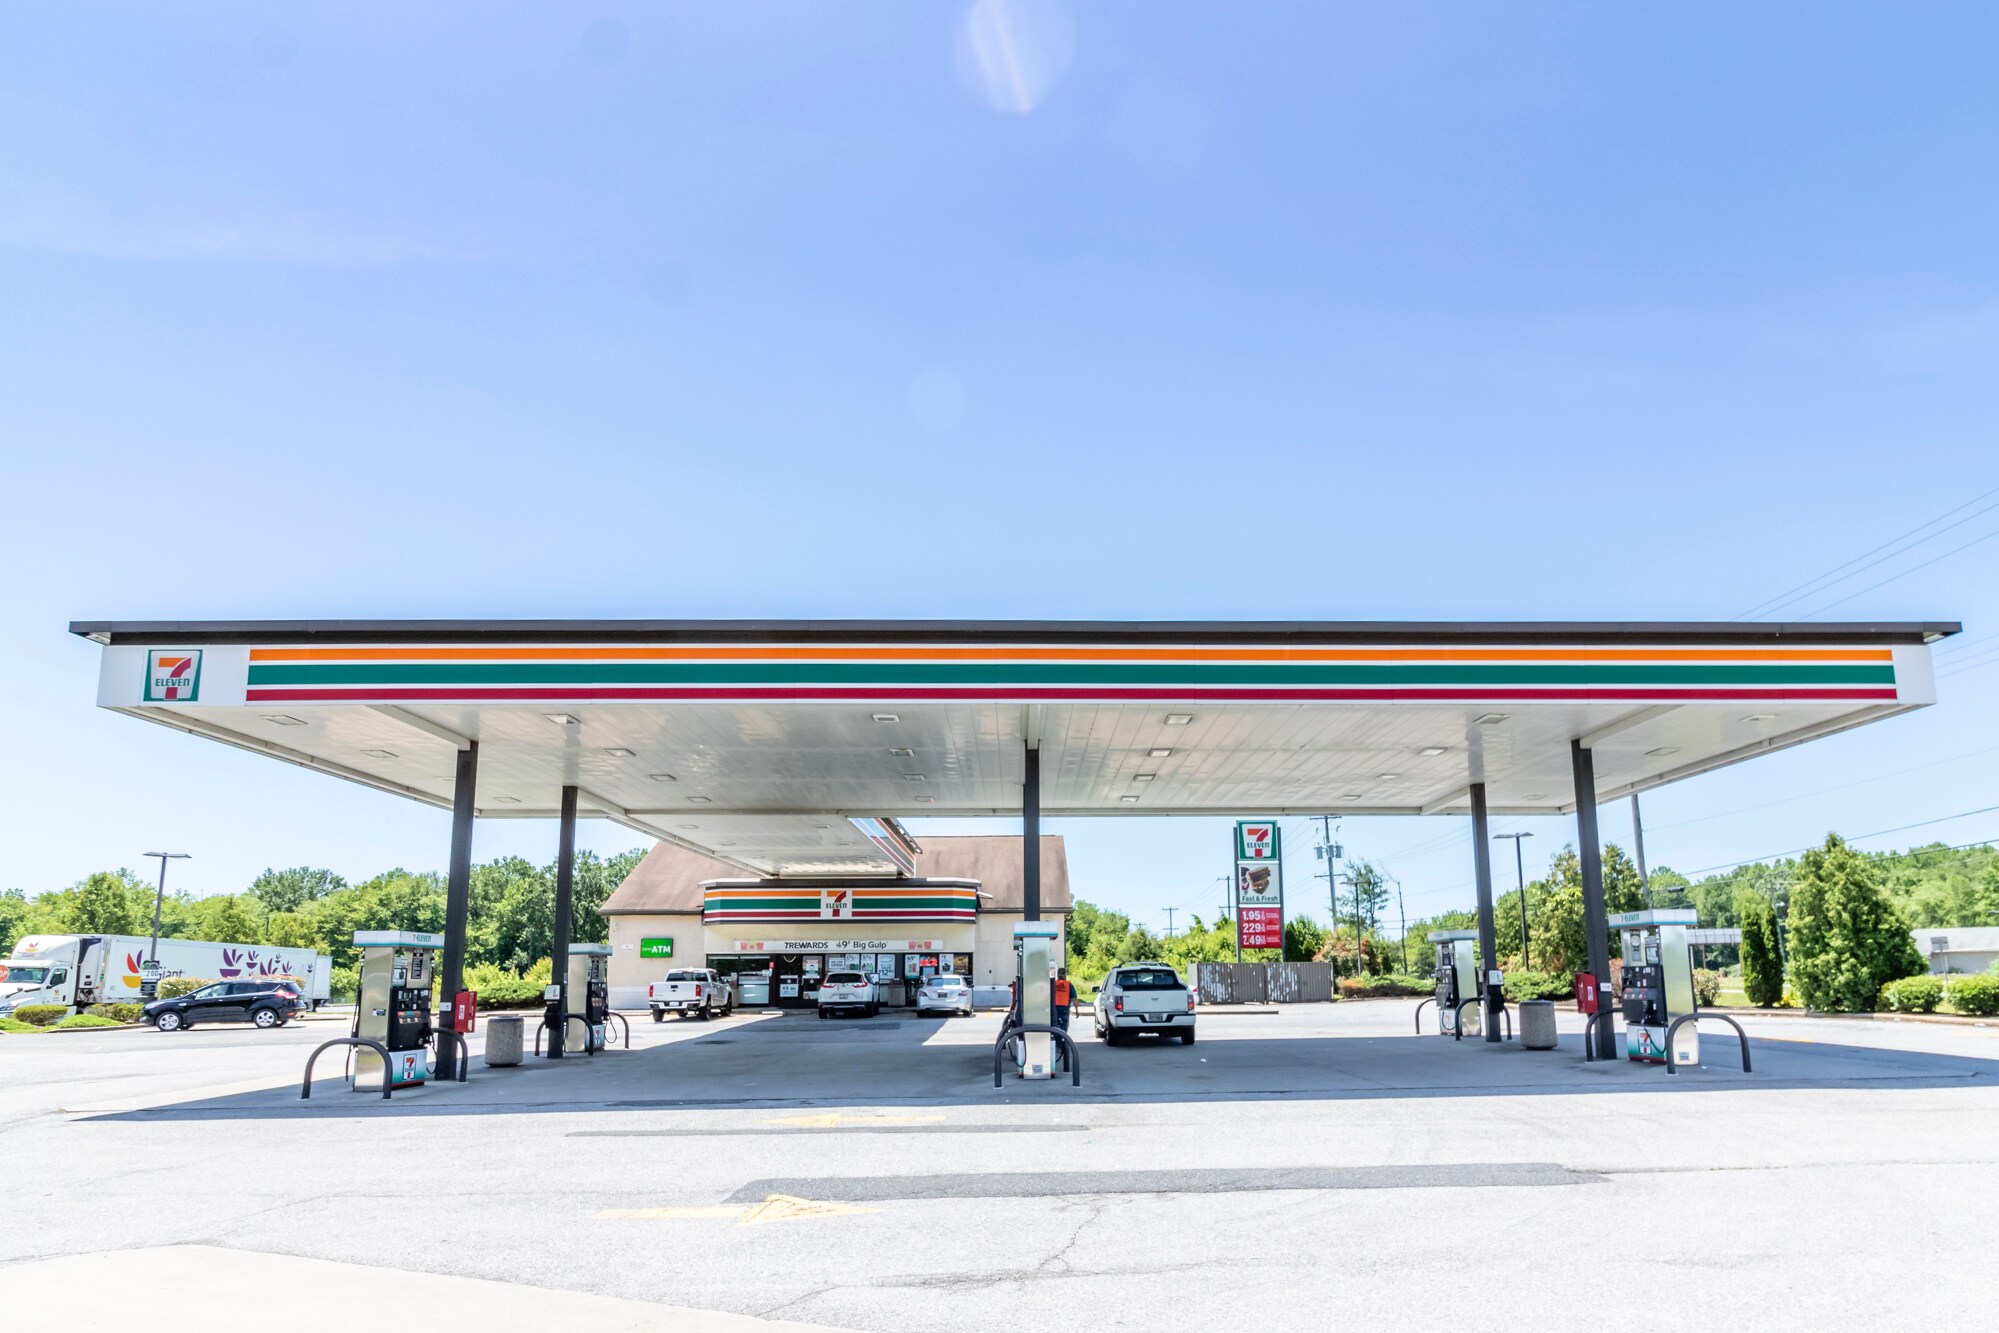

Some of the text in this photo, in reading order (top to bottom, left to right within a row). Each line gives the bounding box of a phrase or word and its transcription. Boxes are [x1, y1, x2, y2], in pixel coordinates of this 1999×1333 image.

[158, 657, 192, 699] 7
[1247, 828, 1269, 857] 7
[651, 945, 671, 953] ATM
[853, 941, 866, 950] Big
[868, 941, 886, 949] Gulp
